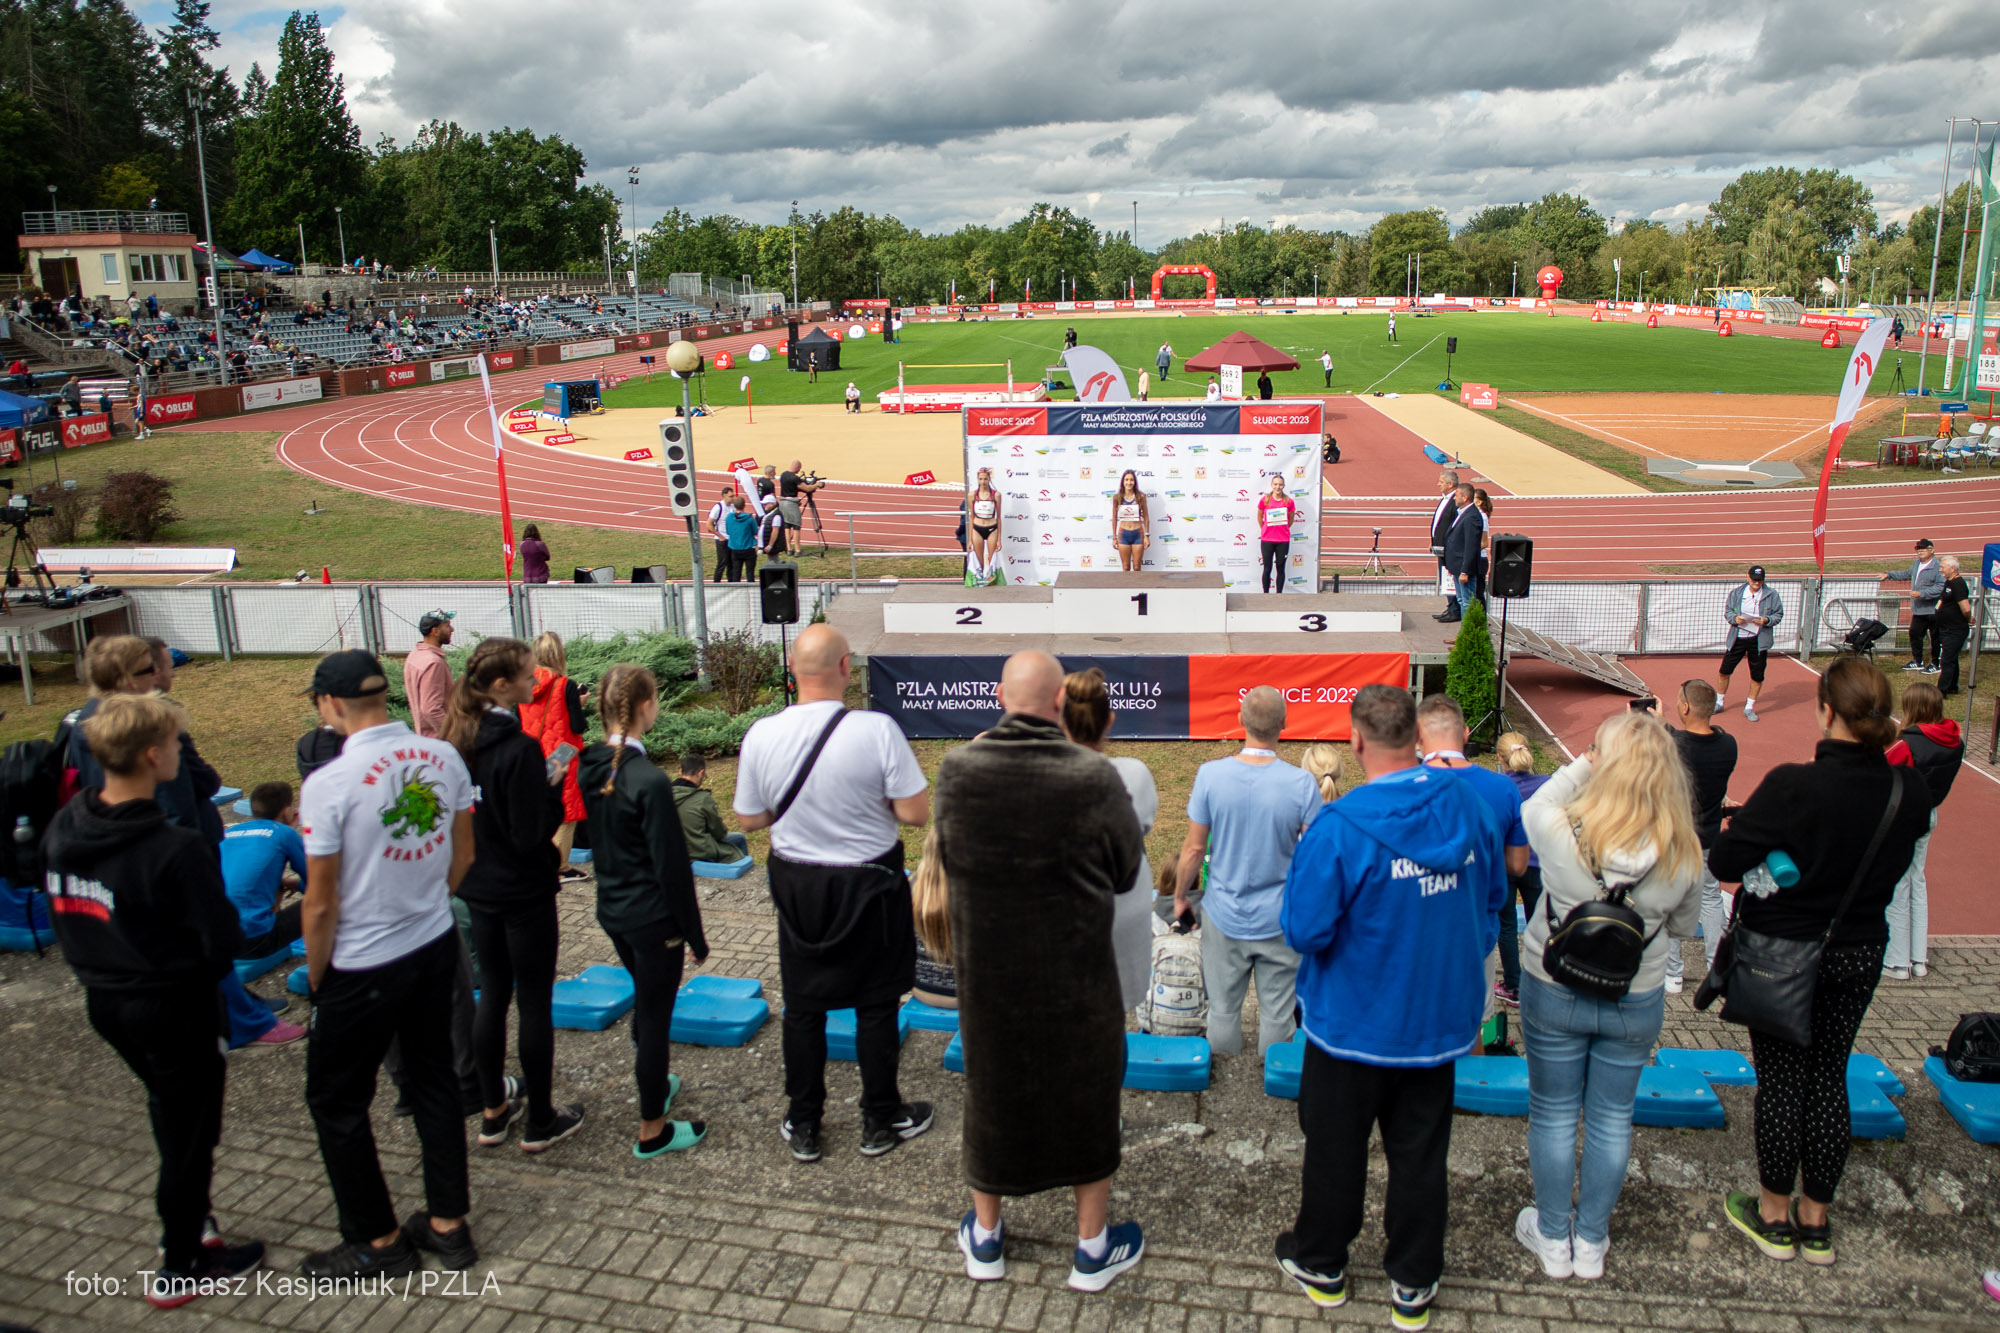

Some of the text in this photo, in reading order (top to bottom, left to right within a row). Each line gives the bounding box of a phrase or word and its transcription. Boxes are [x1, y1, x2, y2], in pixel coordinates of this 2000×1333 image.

[398, 370, 415, 379] ORLEN
[166, 401, 194, 414] ORLEN
[979, 417, 1035, 426] SŁUBICE 2023
[1081, 413, 1207, 421] PZLA MISTRZOSTWA POLSKI U16
[1253, 415, 1310, 425] SŁUBICE 2023
[81, 421, 107, 436] ORLEN
[31, 431, 60, 450] FUEL
[630, 451, 649, 459] PZLA
[912, 473, 932, 484] PZLA
[1131, 592, 1148, 616] 1
[955, 606, 983, 625] 2
[1299, 613, 1328, 632] 3
[896, 681, 999, 696] PZLA MISTRZ
[1103, 681, 1162, 696] SKI U16
[1238, 687, 1359, 703] SICE 2023
[902, 699, 1002, 710] MAŁY MEMORIAŁ
[361, 756, 393, 787] WKS
[1418, 872, 1458, 898] TEAM
[1178, 990, 1193, 1001] 18
